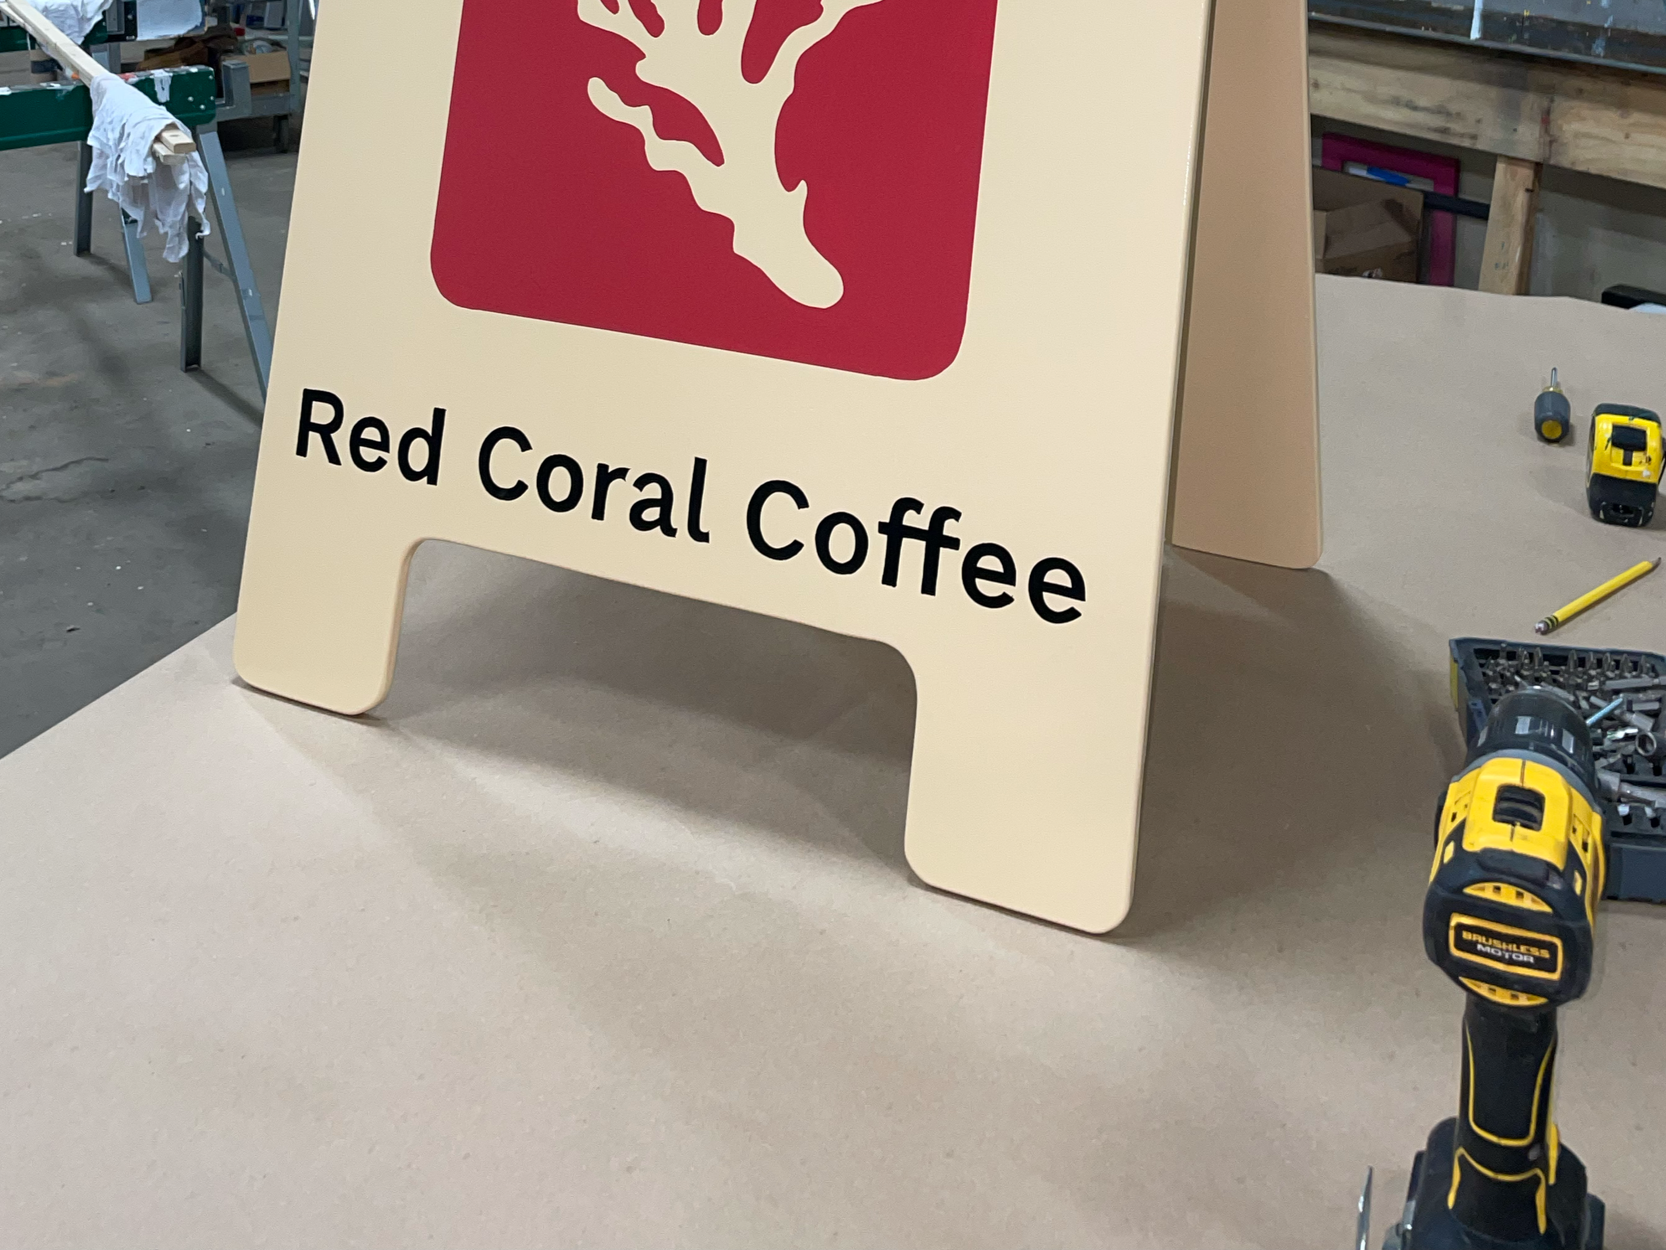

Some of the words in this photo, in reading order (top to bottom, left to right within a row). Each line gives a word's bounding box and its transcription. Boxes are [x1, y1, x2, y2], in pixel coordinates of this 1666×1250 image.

[296, 388, 447, 486] Red
[479, 426, 710, 544] Coral
[747, 480, 1086, 624] Coffee
[1462, 931, 1551, 959] BRUSHLESS
[1476, 943, 1535, 963] MOTOR
